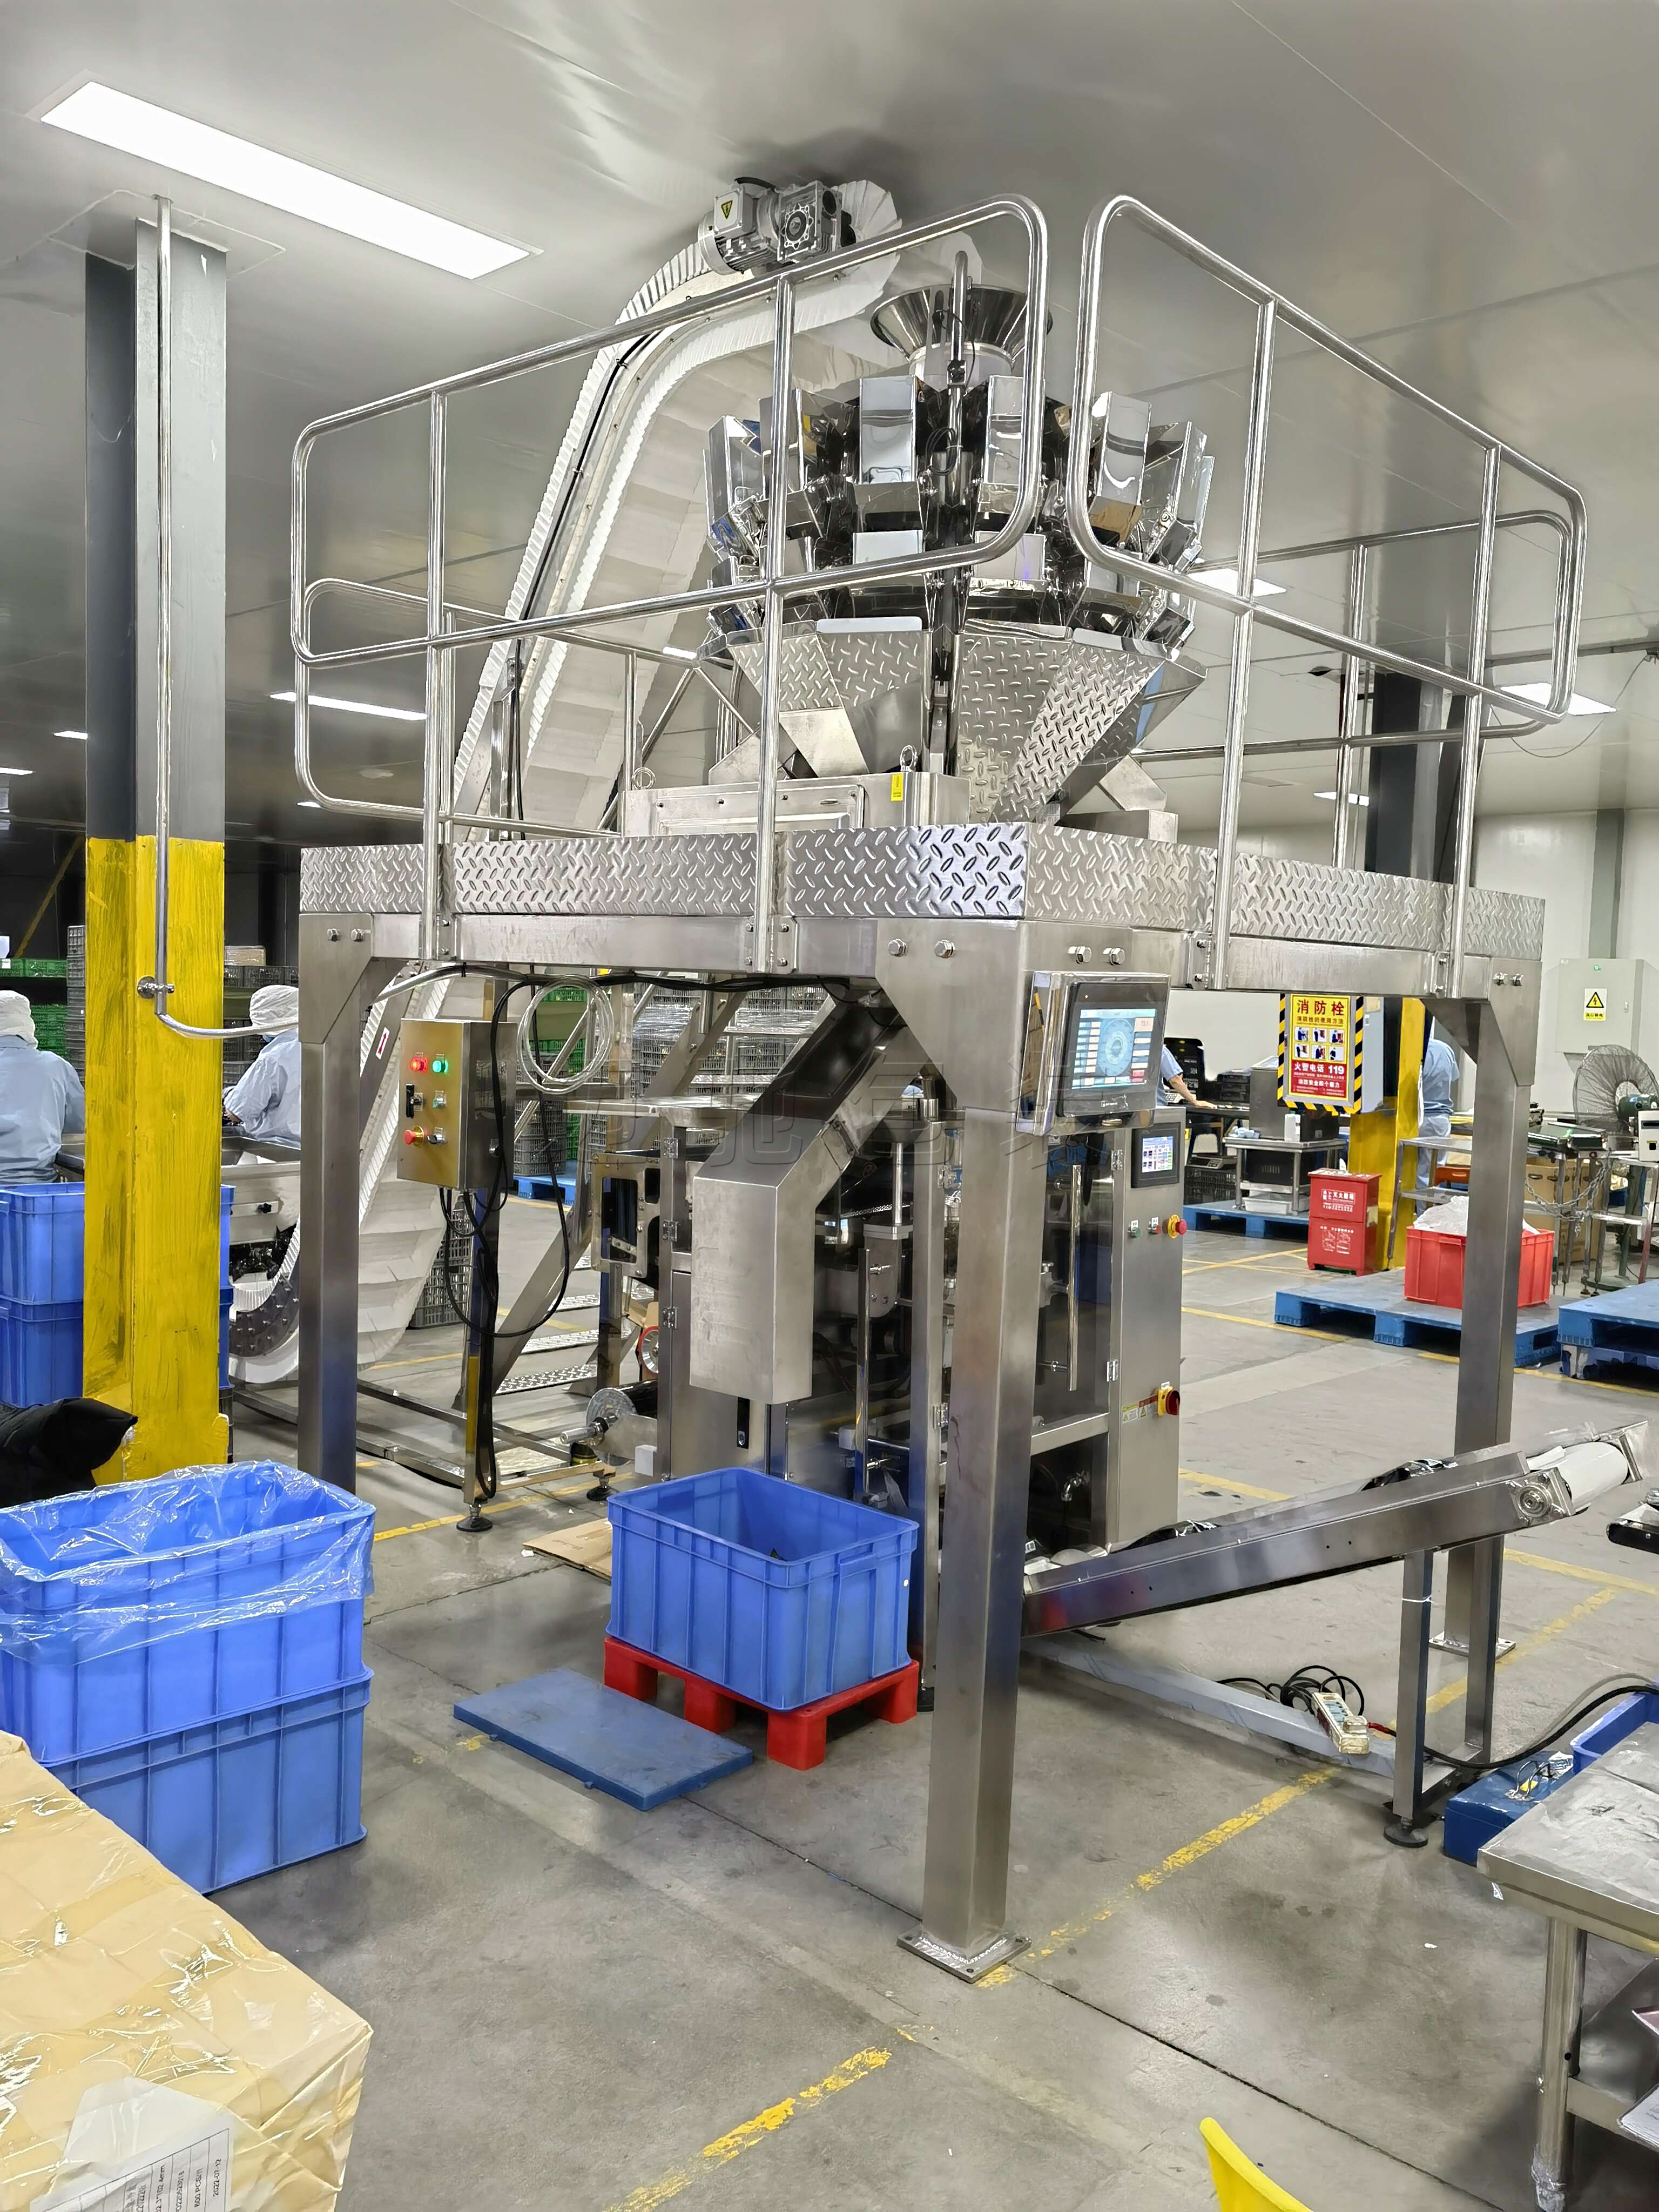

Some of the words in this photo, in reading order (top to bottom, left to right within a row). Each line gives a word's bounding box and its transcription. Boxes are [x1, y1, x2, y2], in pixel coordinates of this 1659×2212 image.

[1297, 999, 1345, 1016] 消防栓
[1294, 1062, 1324, 1073] 火警电话
[1328, 1065, 1345, 1075] 119
[213, 2158, 221, 2197] 2022-07-12
